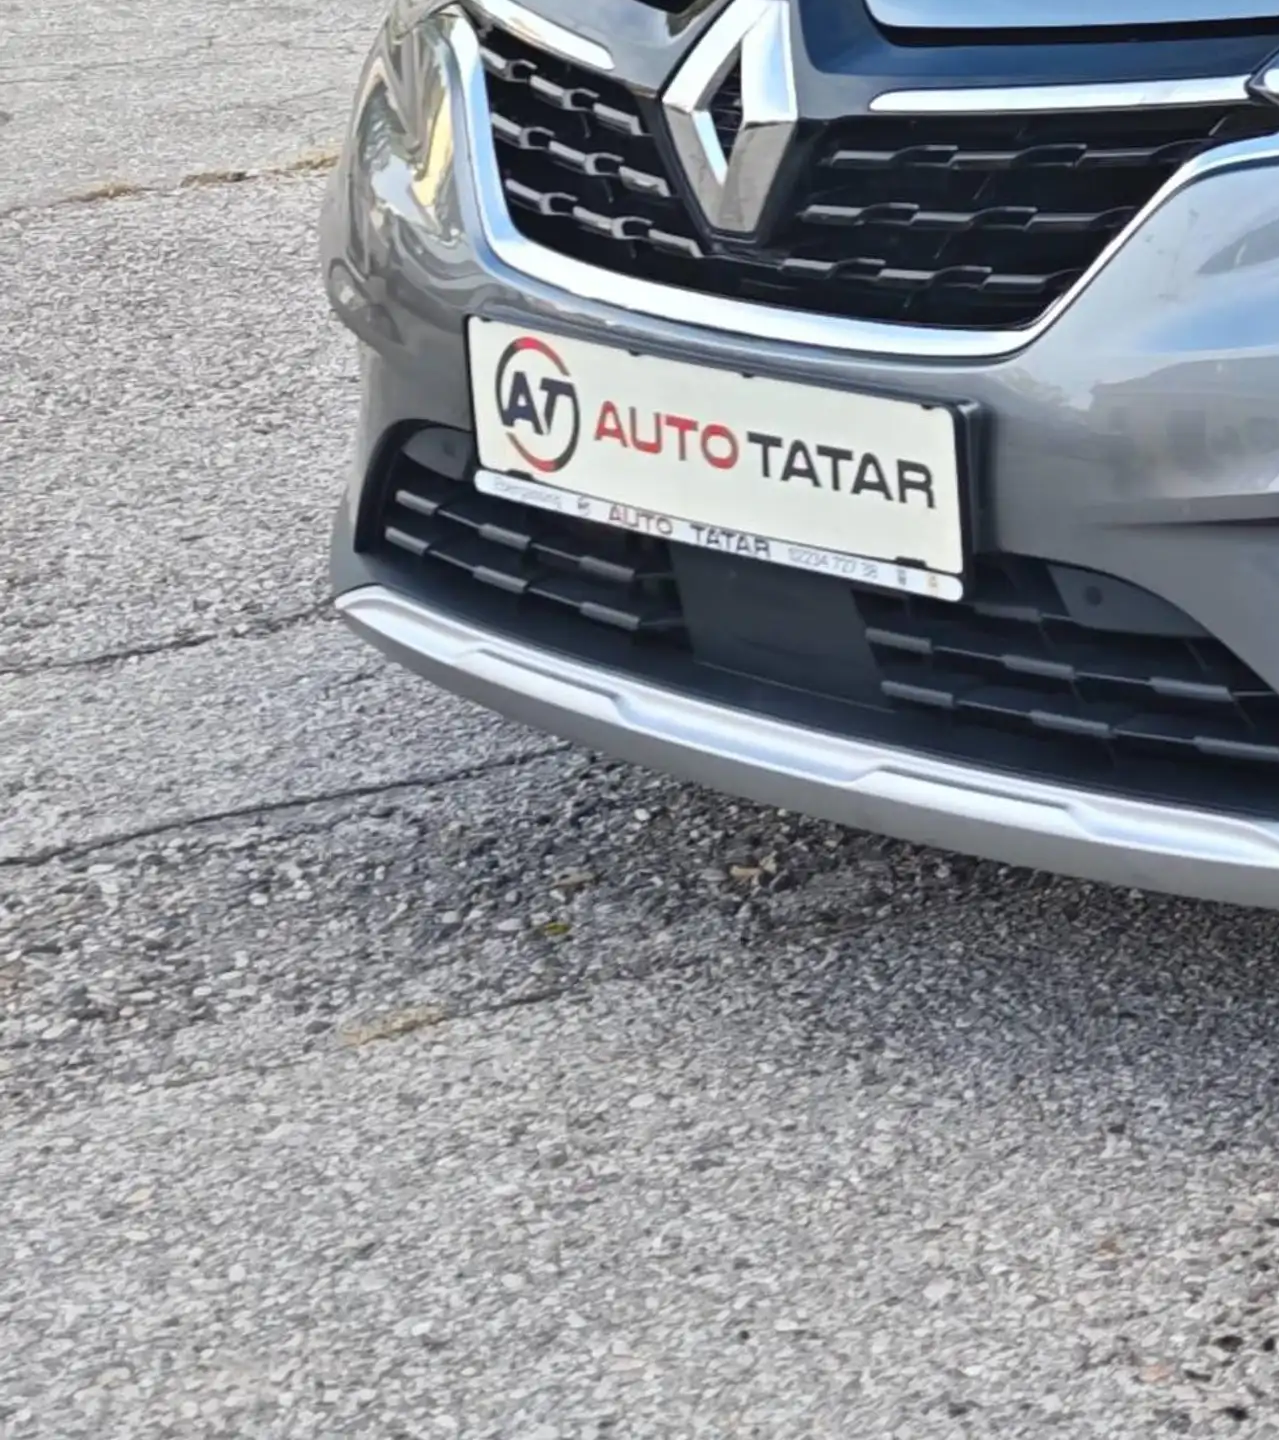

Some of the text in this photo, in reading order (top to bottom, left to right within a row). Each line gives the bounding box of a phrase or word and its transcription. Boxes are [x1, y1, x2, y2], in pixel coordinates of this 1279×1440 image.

[502, 371, 574, 435] AT
[594, 400, 937, 509] AUTO TATAR
[608, 502, 771, 559] AUTO TATAR
